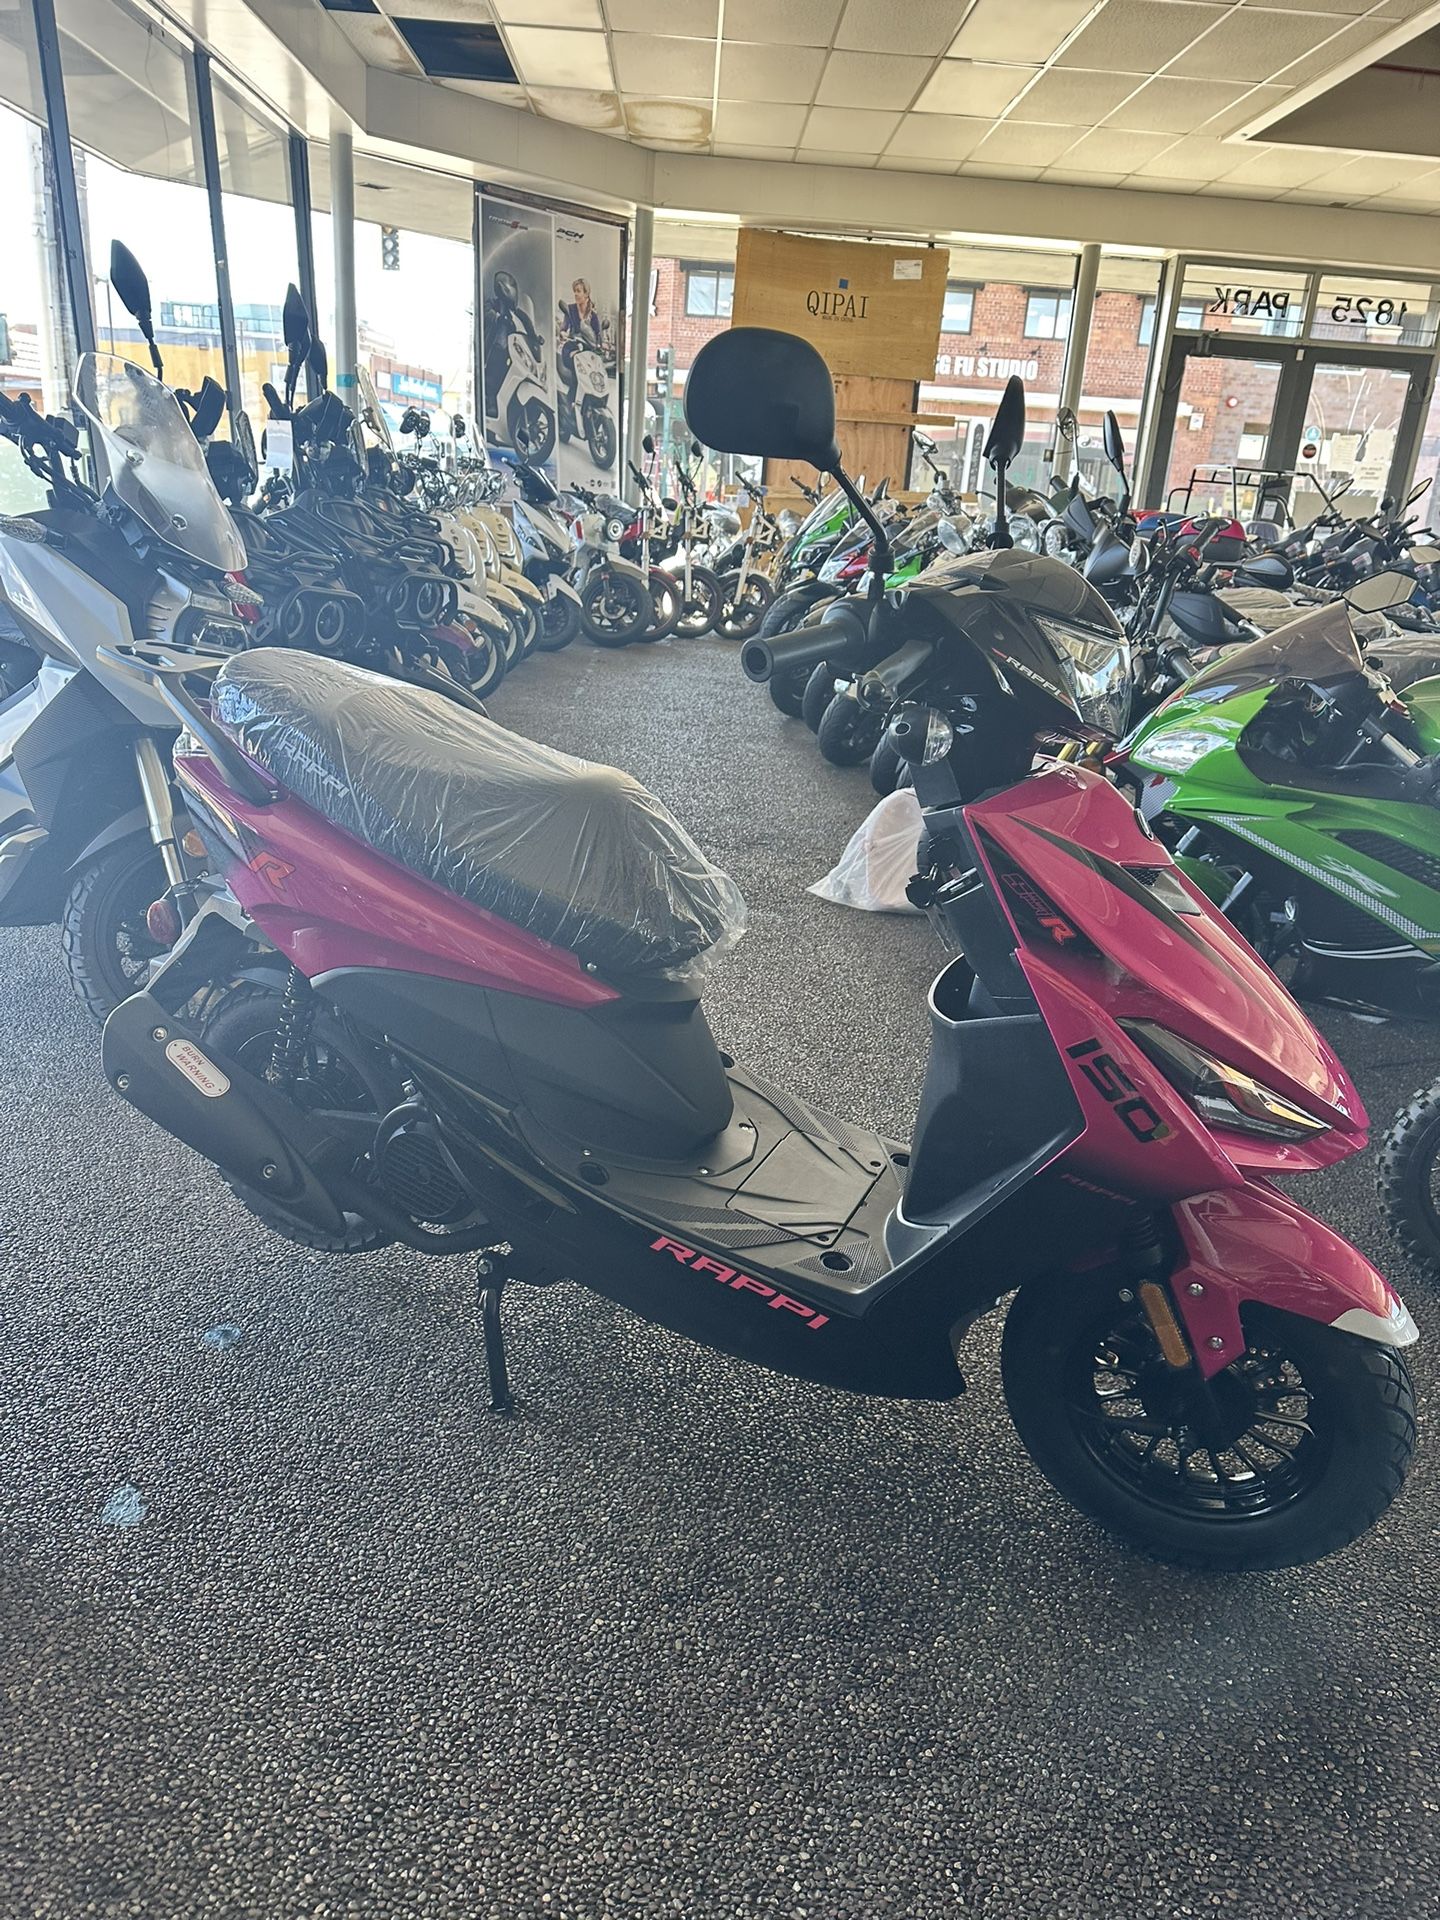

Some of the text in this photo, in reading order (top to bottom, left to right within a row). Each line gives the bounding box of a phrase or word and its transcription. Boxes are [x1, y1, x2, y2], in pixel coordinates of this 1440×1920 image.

[806, 290, 869, 318] QIPAI
[954, 355, 975, 377] FU
[977, 356, 1039, 381] STUDIO
[1006, 656, 1061, 696] RAPPI
[276, 740, 350, 799] RAPPI
[176, 1053, 215, 1089] WARNING
[181, 1045, 205, 1066] BURN
[1065, 1037, 1171, 1143] 150
[649, 1235, 830, 1330] RAPPI
